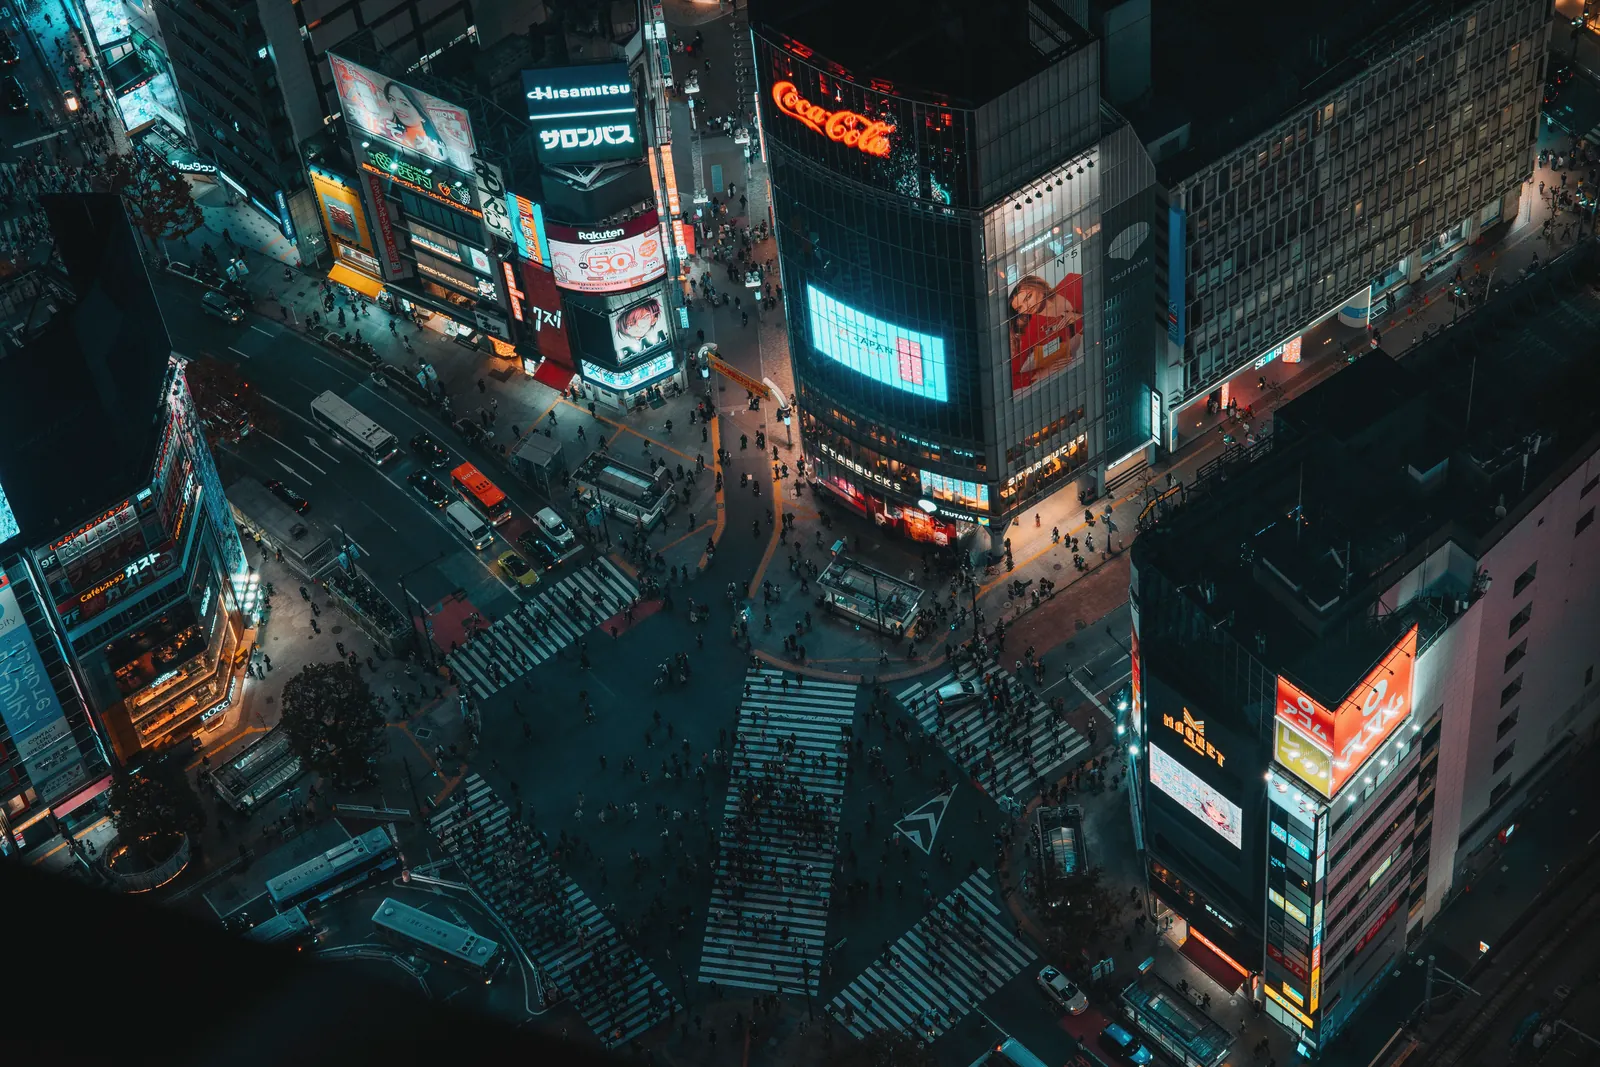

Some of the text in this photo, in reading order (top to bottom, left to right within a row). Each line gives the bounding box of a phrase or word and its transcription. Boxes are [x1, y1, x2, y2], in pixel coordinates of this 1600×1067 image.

[527, 83, 631, 100] Hisamitsu
[539, 124, 635, 150] サロンパス
[577, 227, 625, 241] Rakuten
[1109, 256, 1149, 284] TSUTAYA
[853, 336, 894, 356] JAPAN
[820, 442, 902, 492] STARBUCKS
[1007, 433, 1085, 487] STARBUCKS
[939, 508, 975, 523] TSUTAYA
[41, 554, 56, 569] 9F
[125, 551, 161, 579] ガスト
[12, 638, 51, 713] コンタクトの
[1283, 702, 1328, 742] アコム
[1163, 713, 1226, 768] MAGNET
